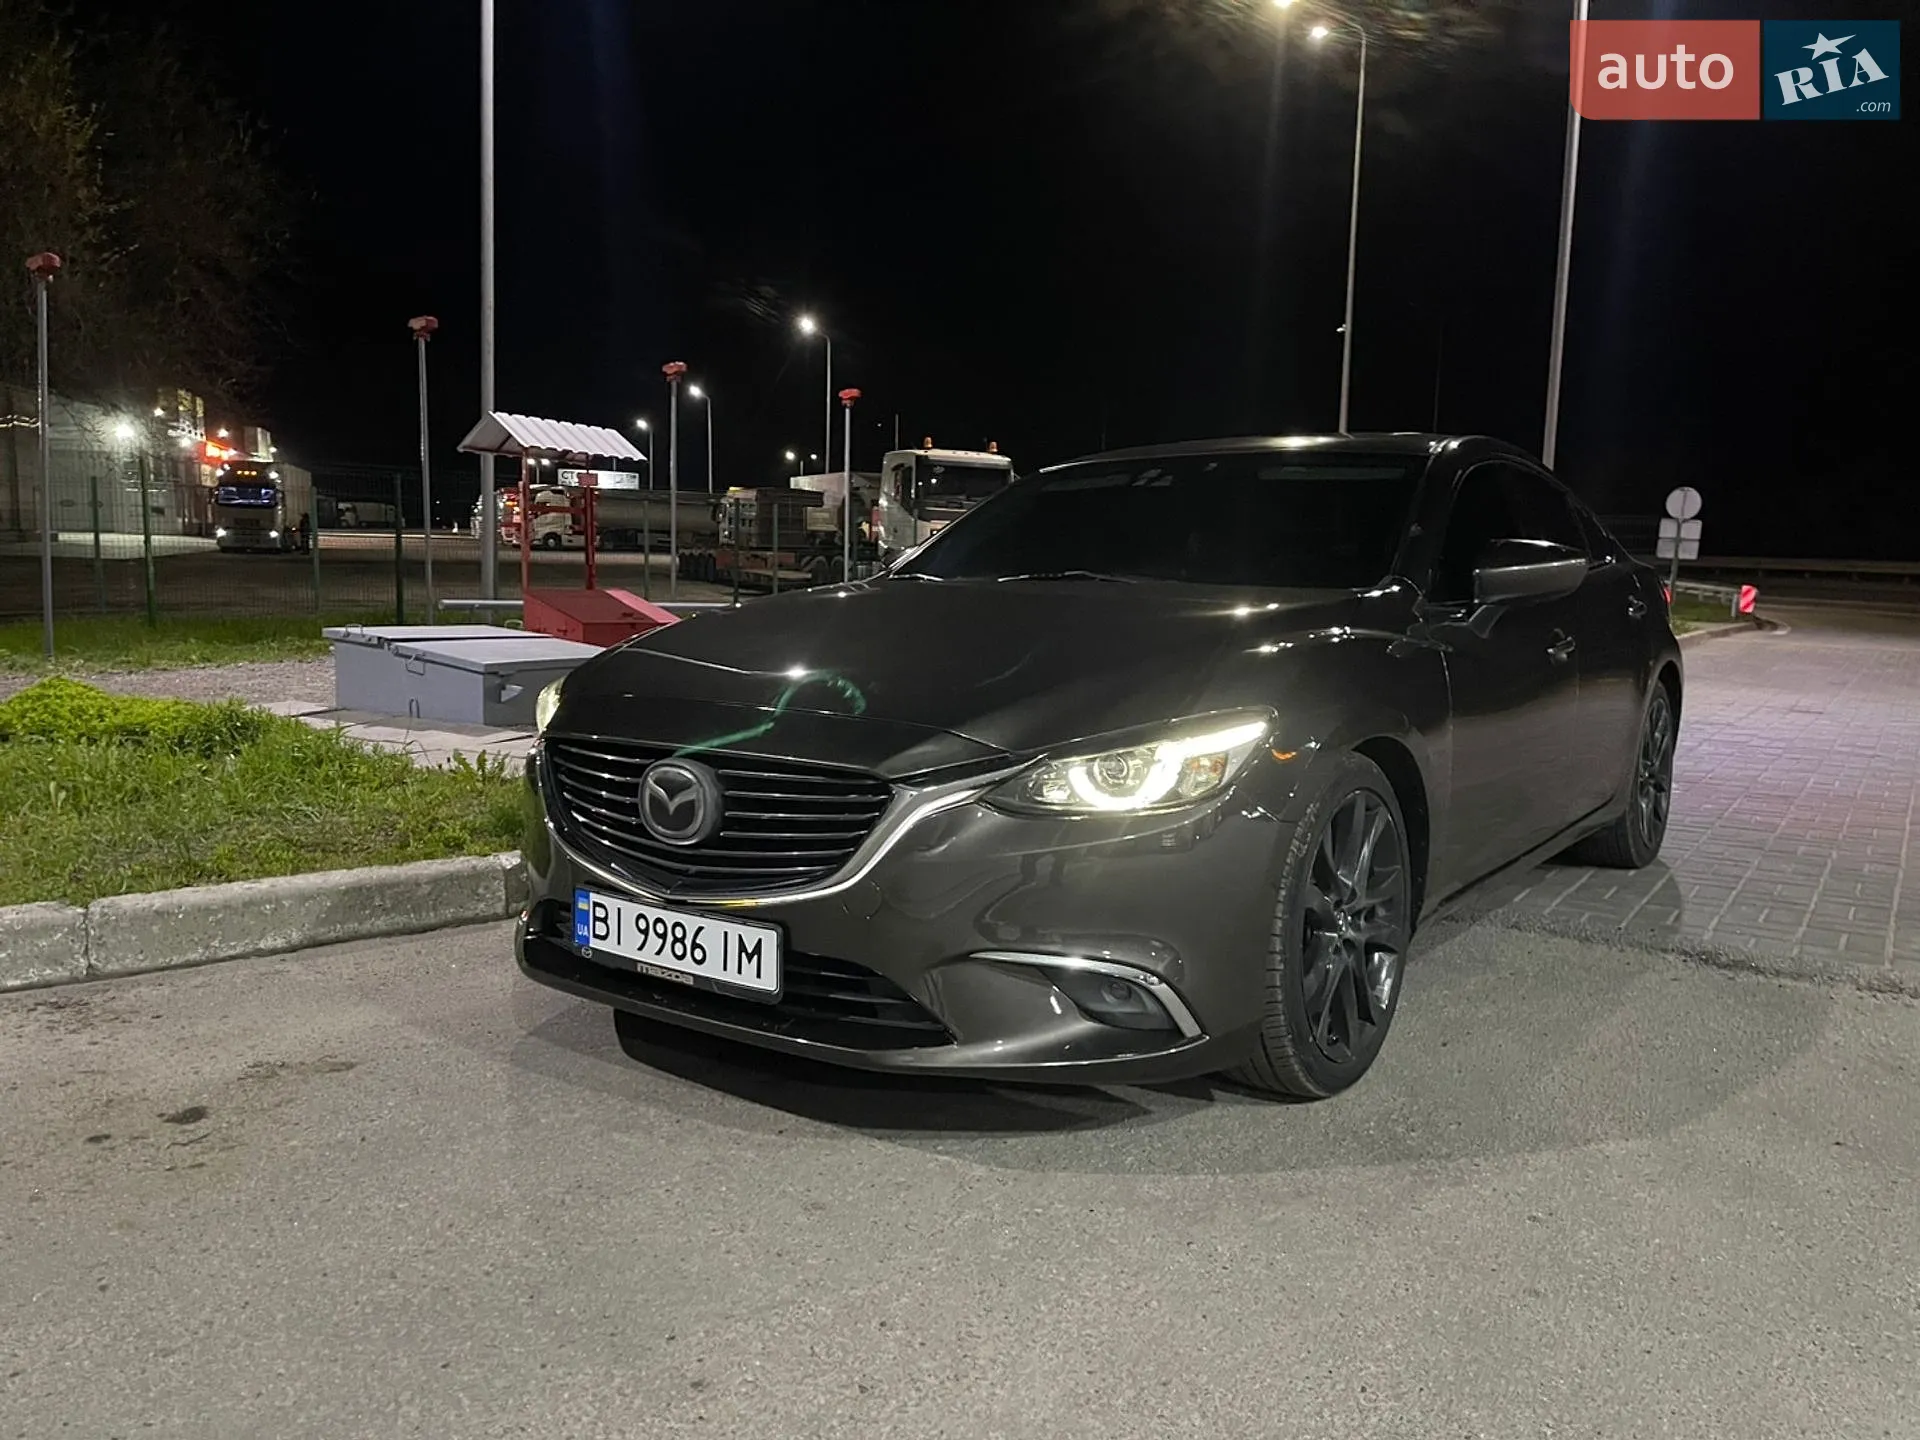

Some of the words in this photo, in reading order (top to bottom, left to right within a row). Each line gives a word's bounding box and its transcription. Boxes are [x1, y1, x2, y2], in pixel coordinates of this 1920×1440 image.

[577, 923, 589, 937] UA
[635, 912, 707, 966] 9986
[636, 962, 694, 985] mazda
